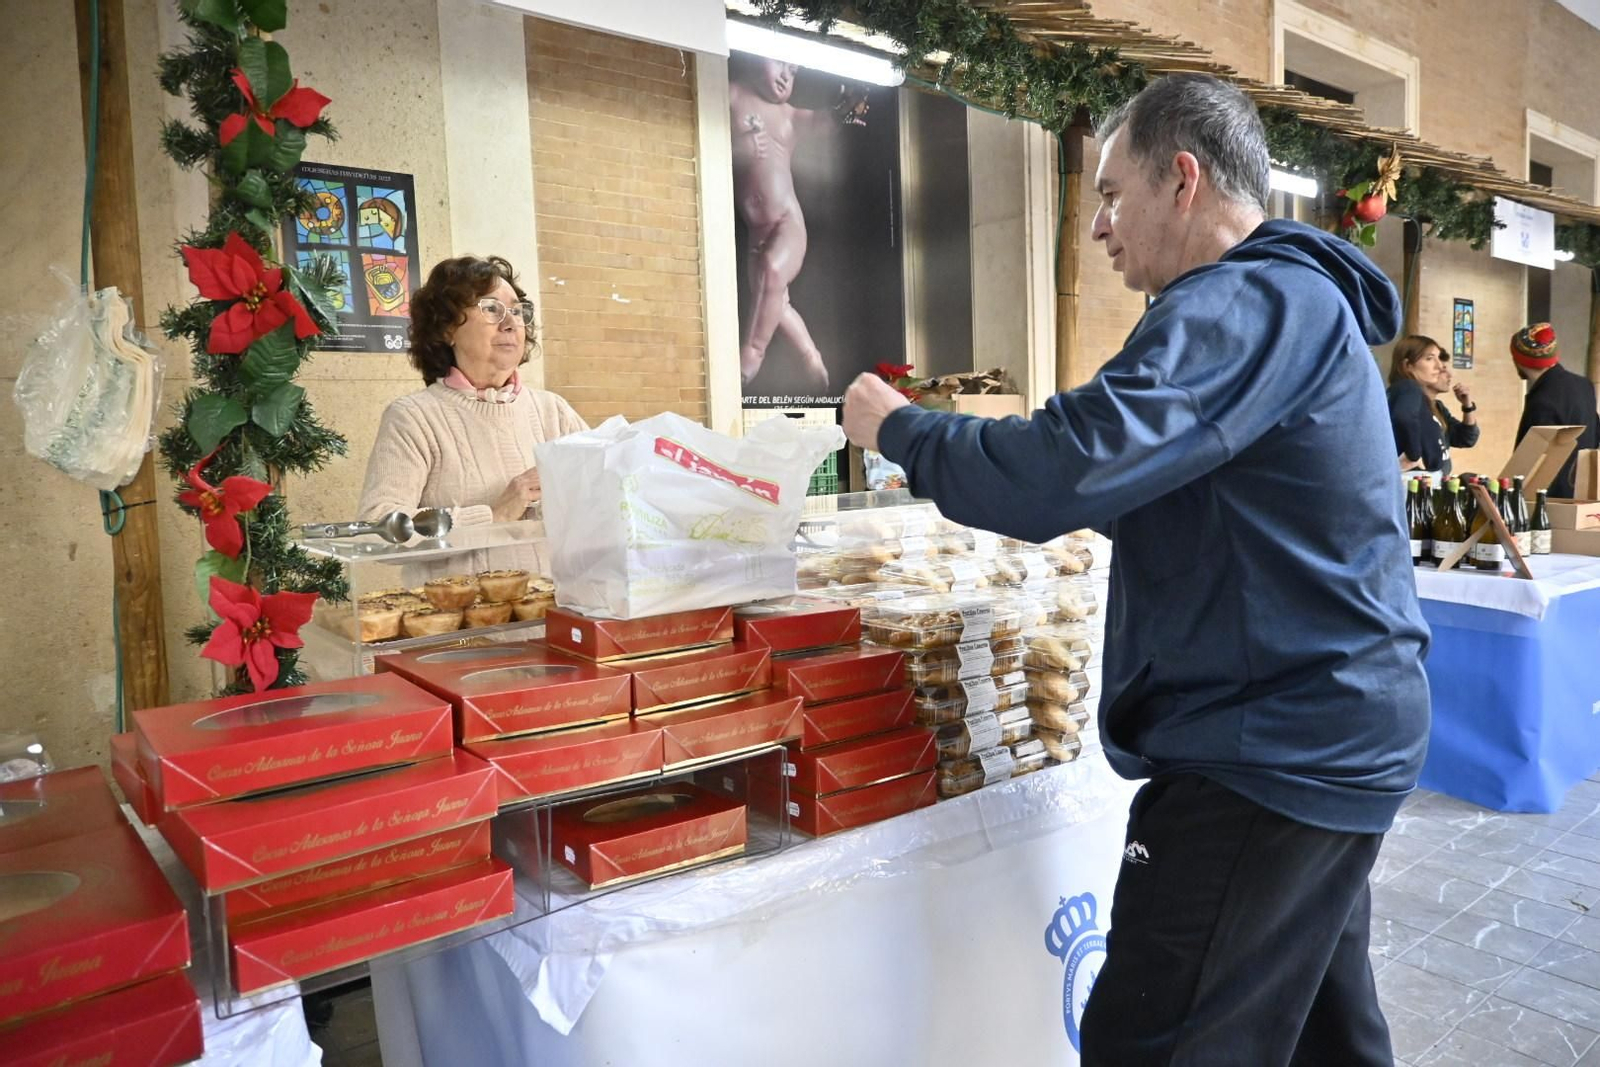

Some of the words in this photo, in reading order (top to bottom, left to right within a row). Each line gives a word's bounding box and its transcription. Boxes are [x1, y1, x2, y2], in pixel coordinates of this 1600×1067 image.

[758, 396, 771, 404] DEL
[772, 395, 793, 404] BELÉN
[793, 395, 814, 404] SEGÚN
[307, 748, 321, 762] de
[326, 746, 339, 759] la
[386, 730, 424, 749] Juana
[353, 822, 369, 836] de
[372, 818, 385, 831] la
[353, 857, 368, 871] de
[371, 854, 383, 867] la
[1067, 956, 1079, 981] MARIS
[1076, 947, 1084, 957] ET
